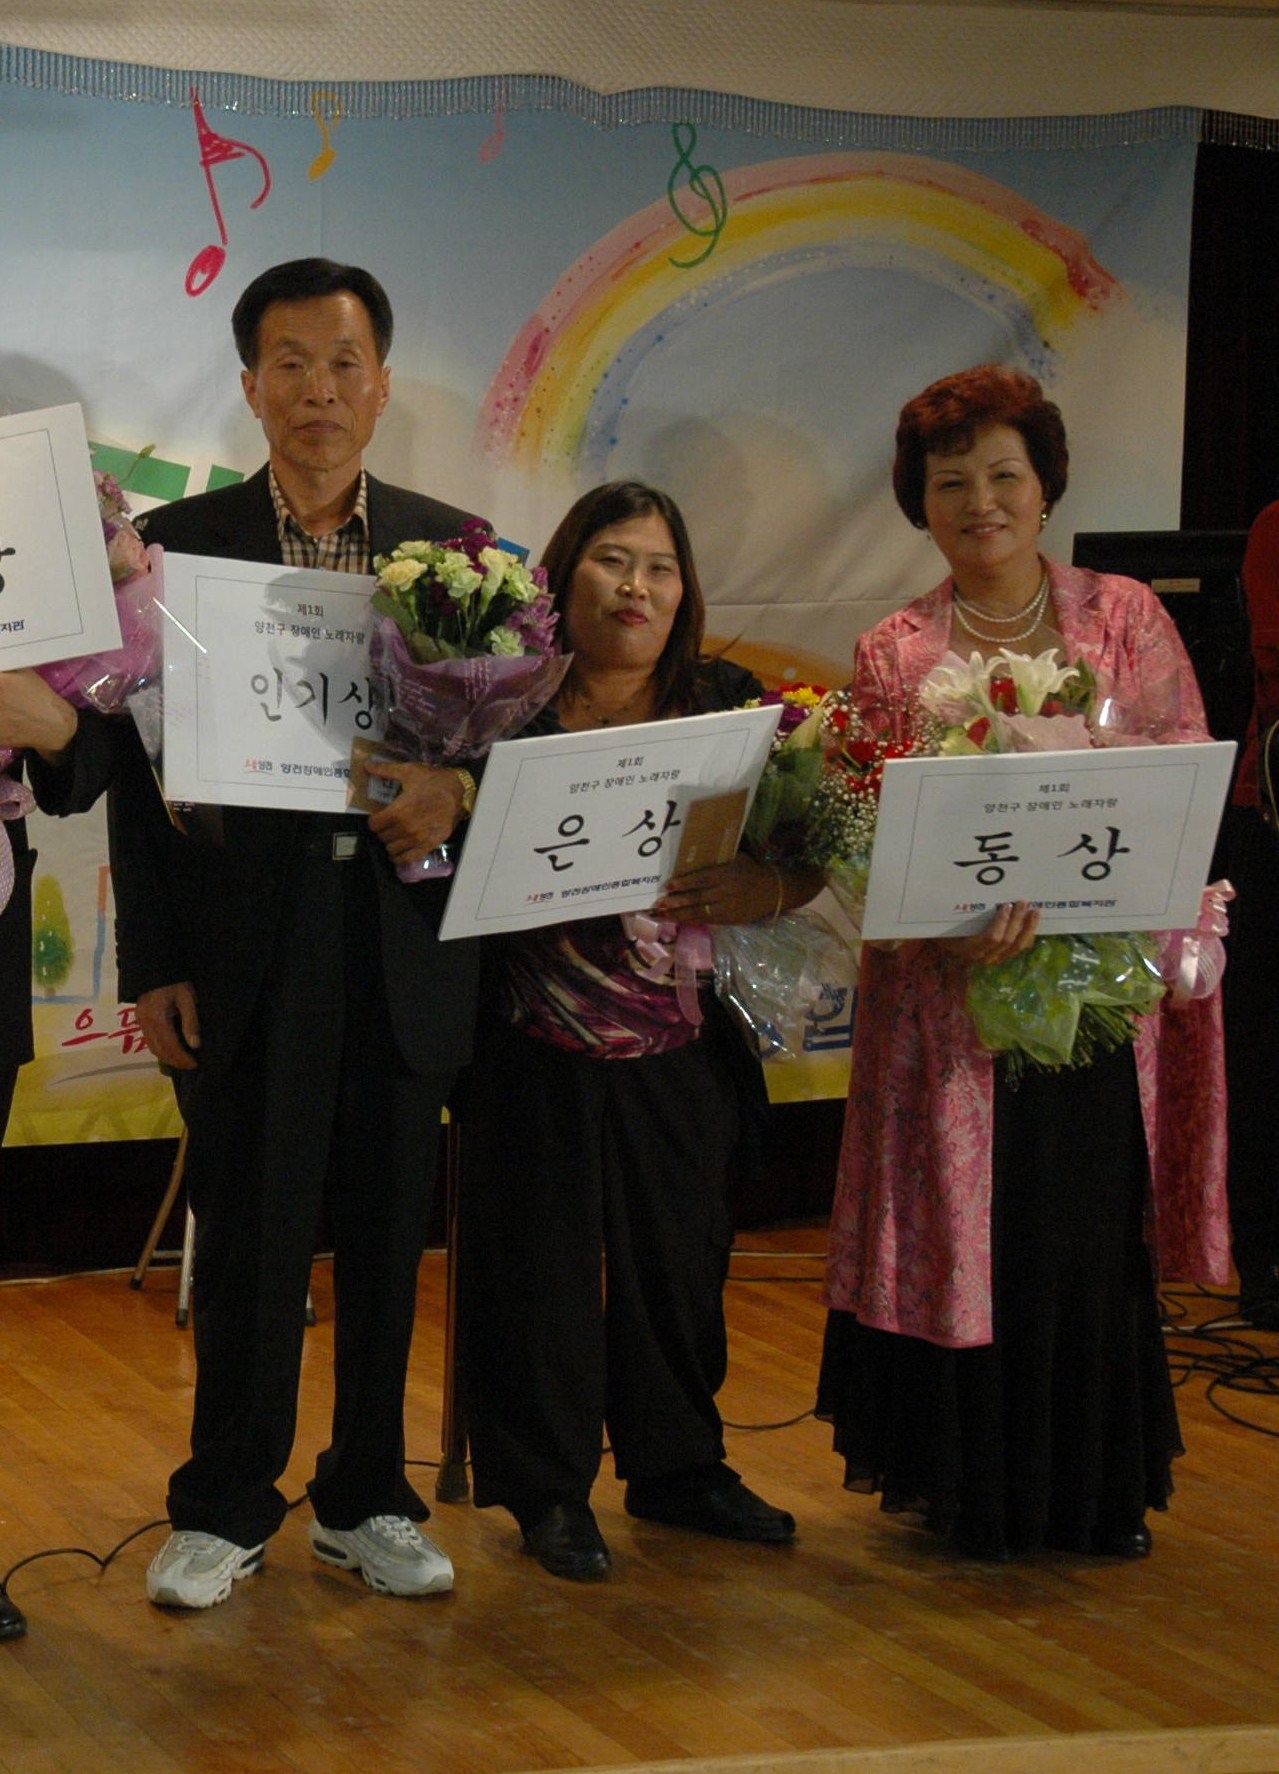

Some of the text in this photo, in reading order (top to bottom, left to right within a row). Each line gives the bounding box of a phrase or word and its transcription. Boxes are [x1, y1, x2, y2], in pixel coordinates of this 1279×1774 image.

[297, 603, 324, 618] 제1회
[254, 621, 365, 645] 양천구 장애인 노래자랑
[617, 756, 644, 769] 제1회
[569, 768, 682, 795] 양천구 장애인 노래자랑
[1038, 782, 1071, 793] 제1회
[984, 797, 1119, 814] 양천구 장애인 노래자랑
